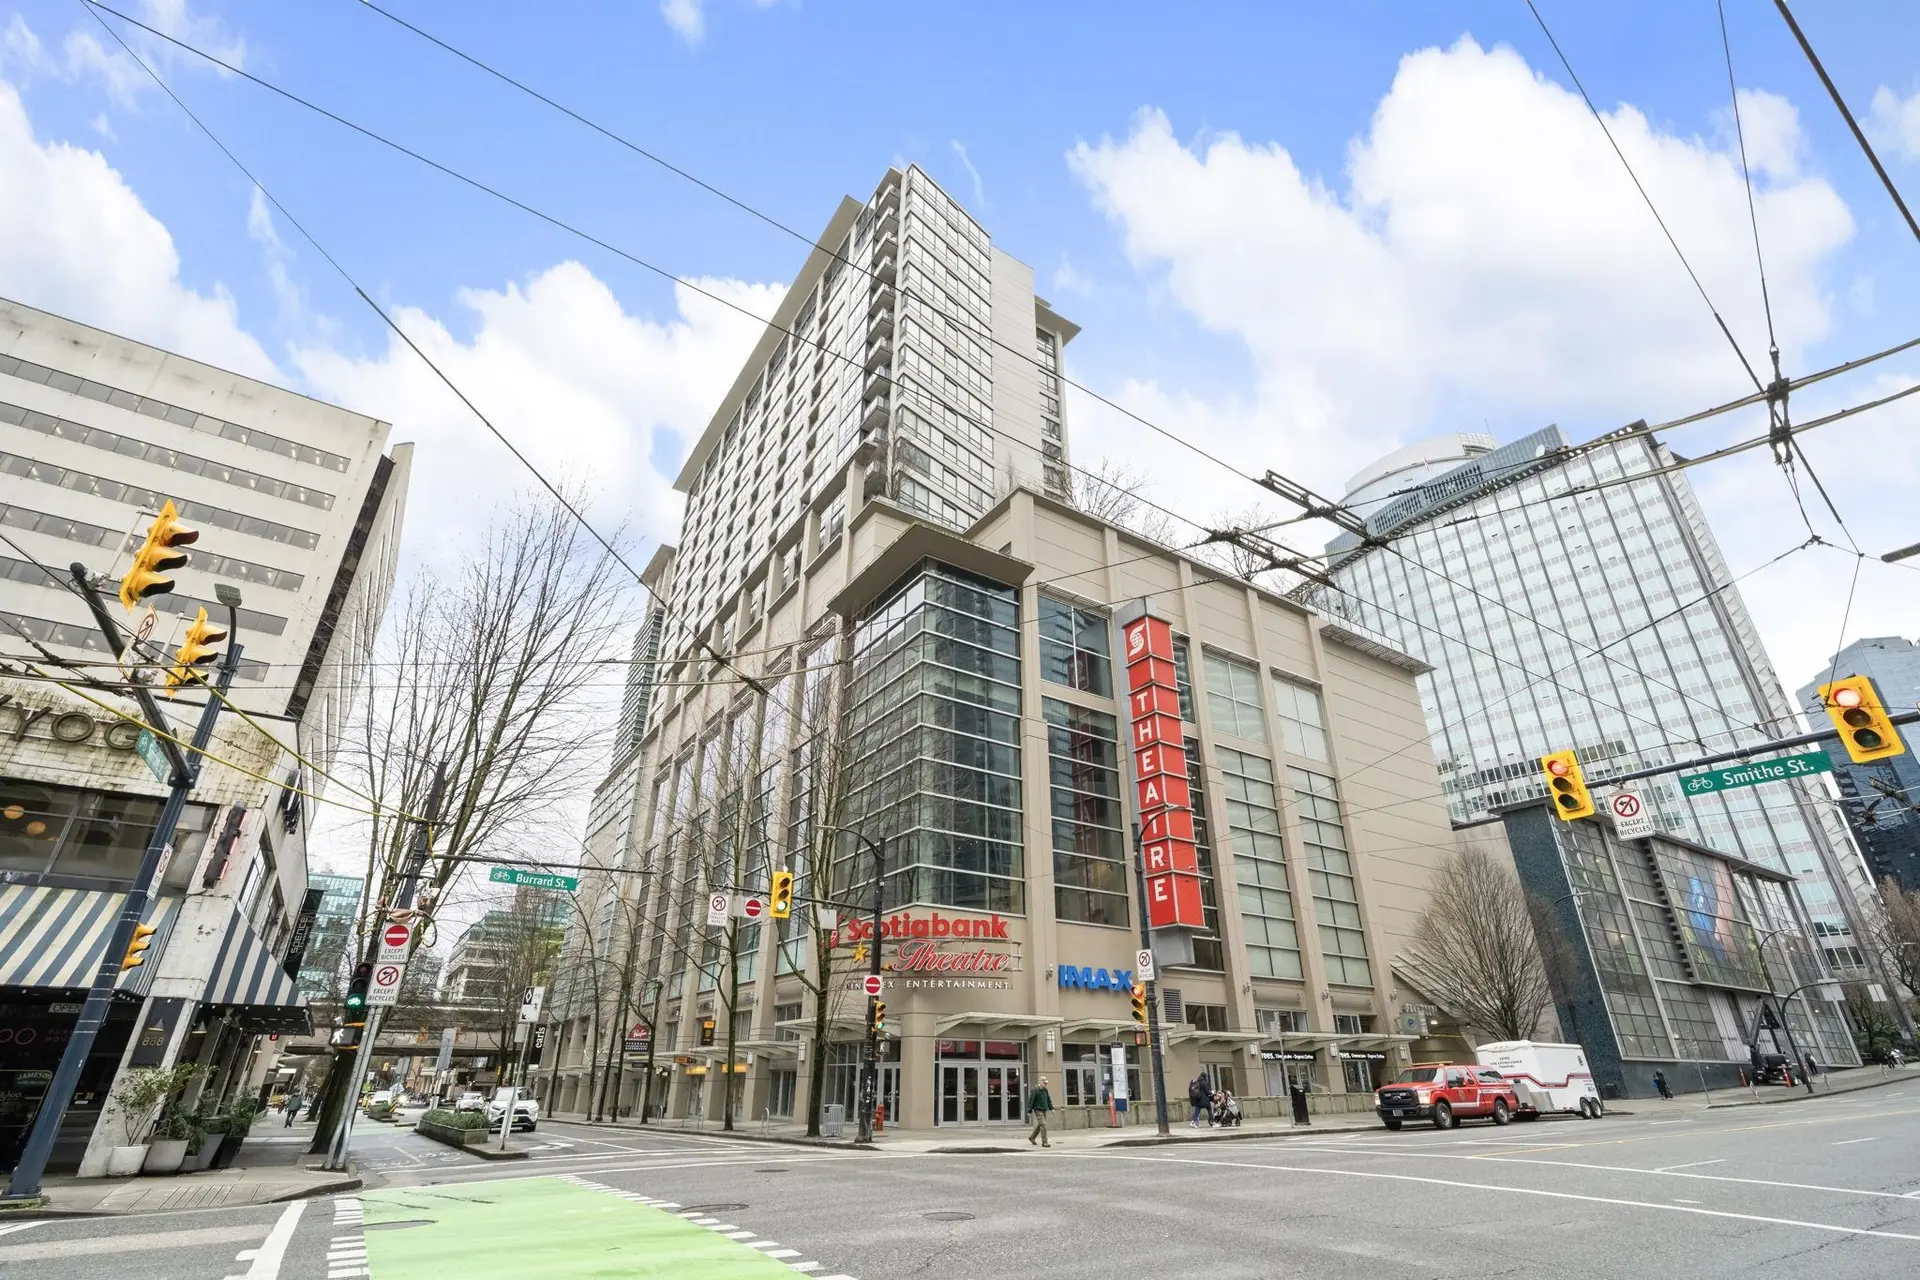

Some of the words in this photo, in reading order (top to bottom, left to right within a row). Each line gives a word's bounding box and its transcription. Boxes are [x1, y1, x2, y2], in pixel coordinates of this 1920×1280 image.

[1722, 764, 1785, 785] Smithe
[1787, 759, 1815, 774] St.
[1136, 691, 1168, 902] THEATRE
[1619, 825, 1651, 836] BICYCLES
[1620, 817, 1645, 827] EXCEPT
[516, 873, 553, 886] Burrard
[555, 877, 568, 888] St.
[847, 912, 1009, 941] Scotiabank
[892, 938, 1009, 973] Theatre
[906, 979, 1010, 990] ENTERTAINMENT
[1058, 964, 1133, 991] IMAX
[535, 1026, 546, 1048] earls
